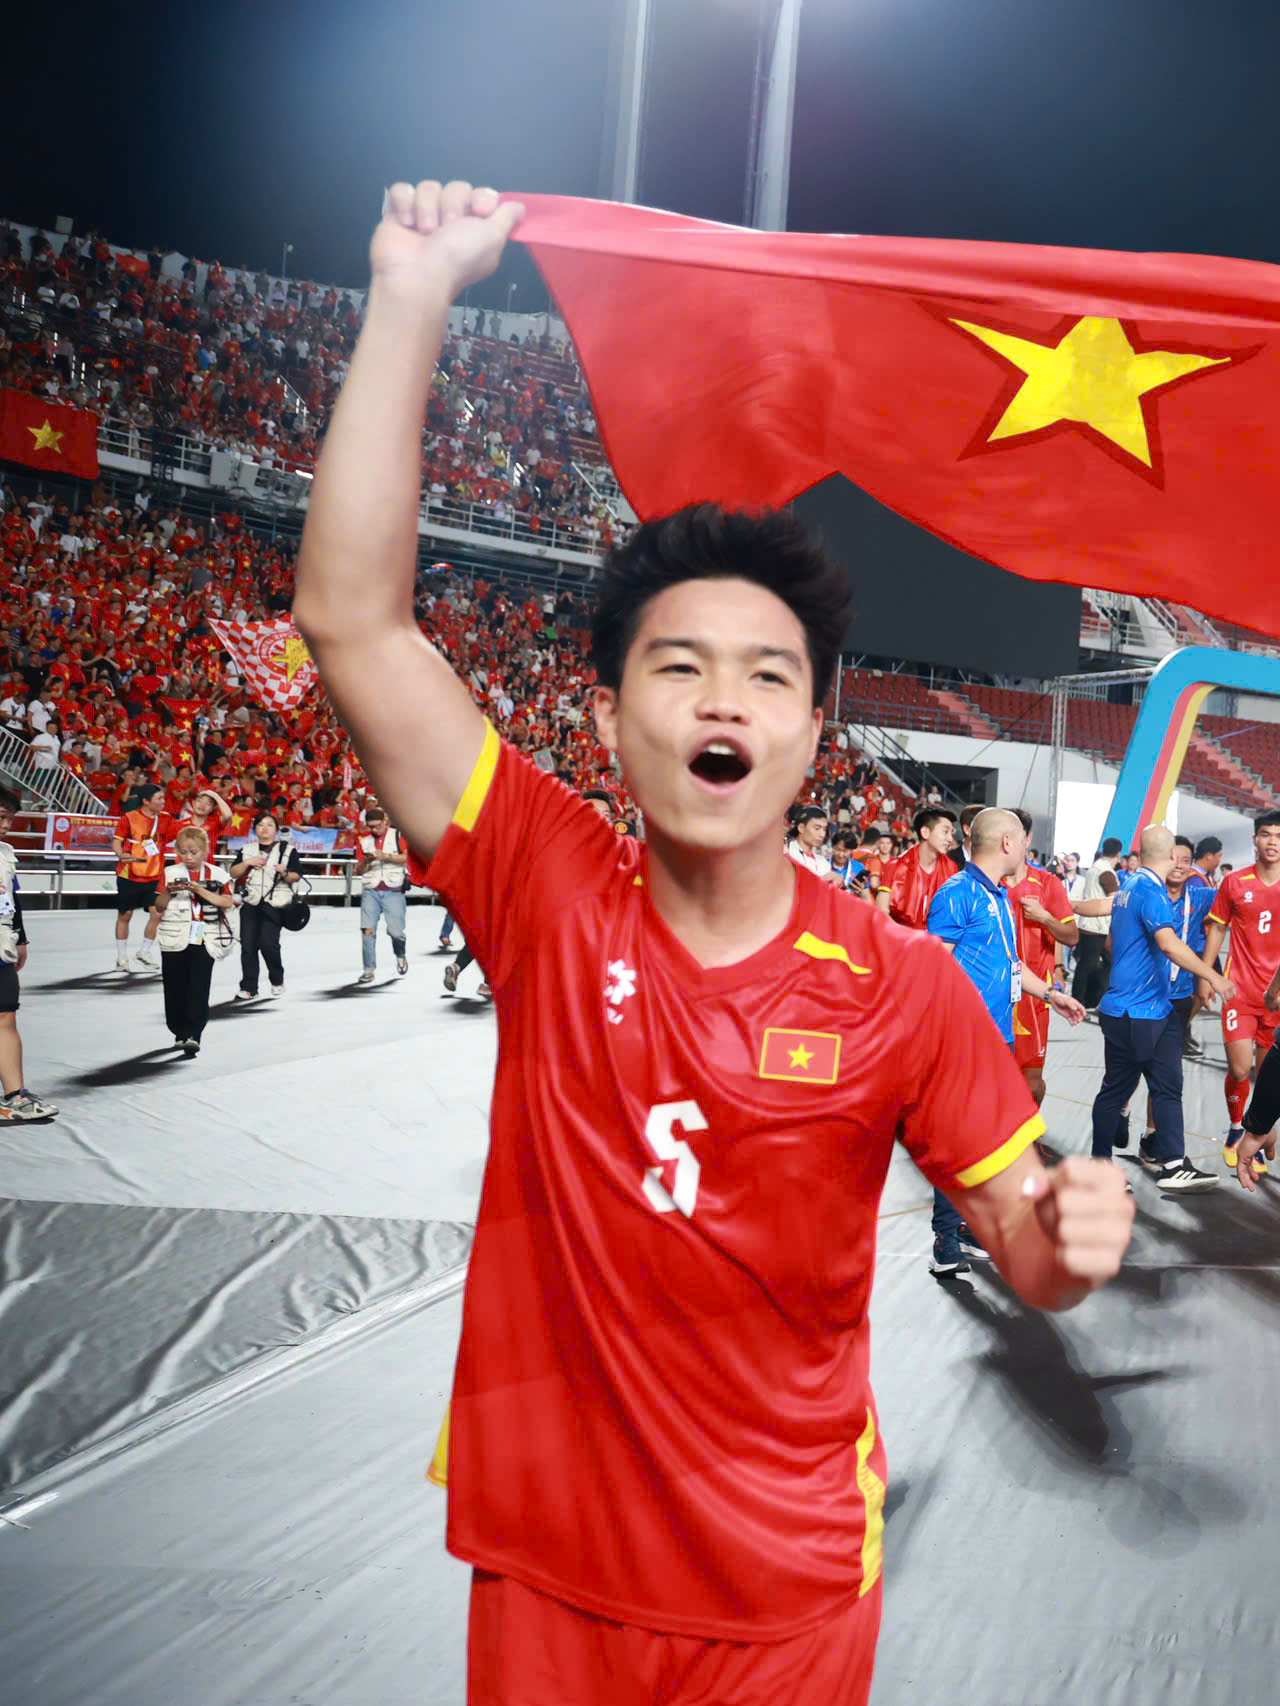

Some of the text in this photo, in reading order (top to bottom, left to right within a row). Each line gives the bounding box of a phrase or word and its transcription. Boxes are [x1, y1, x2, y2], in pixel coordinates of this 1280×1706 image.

[1258, 910, 1272, 934] 2
[1226, 1008, 1238, 1031] 2
[642, 1100, 709, 1219] 5
